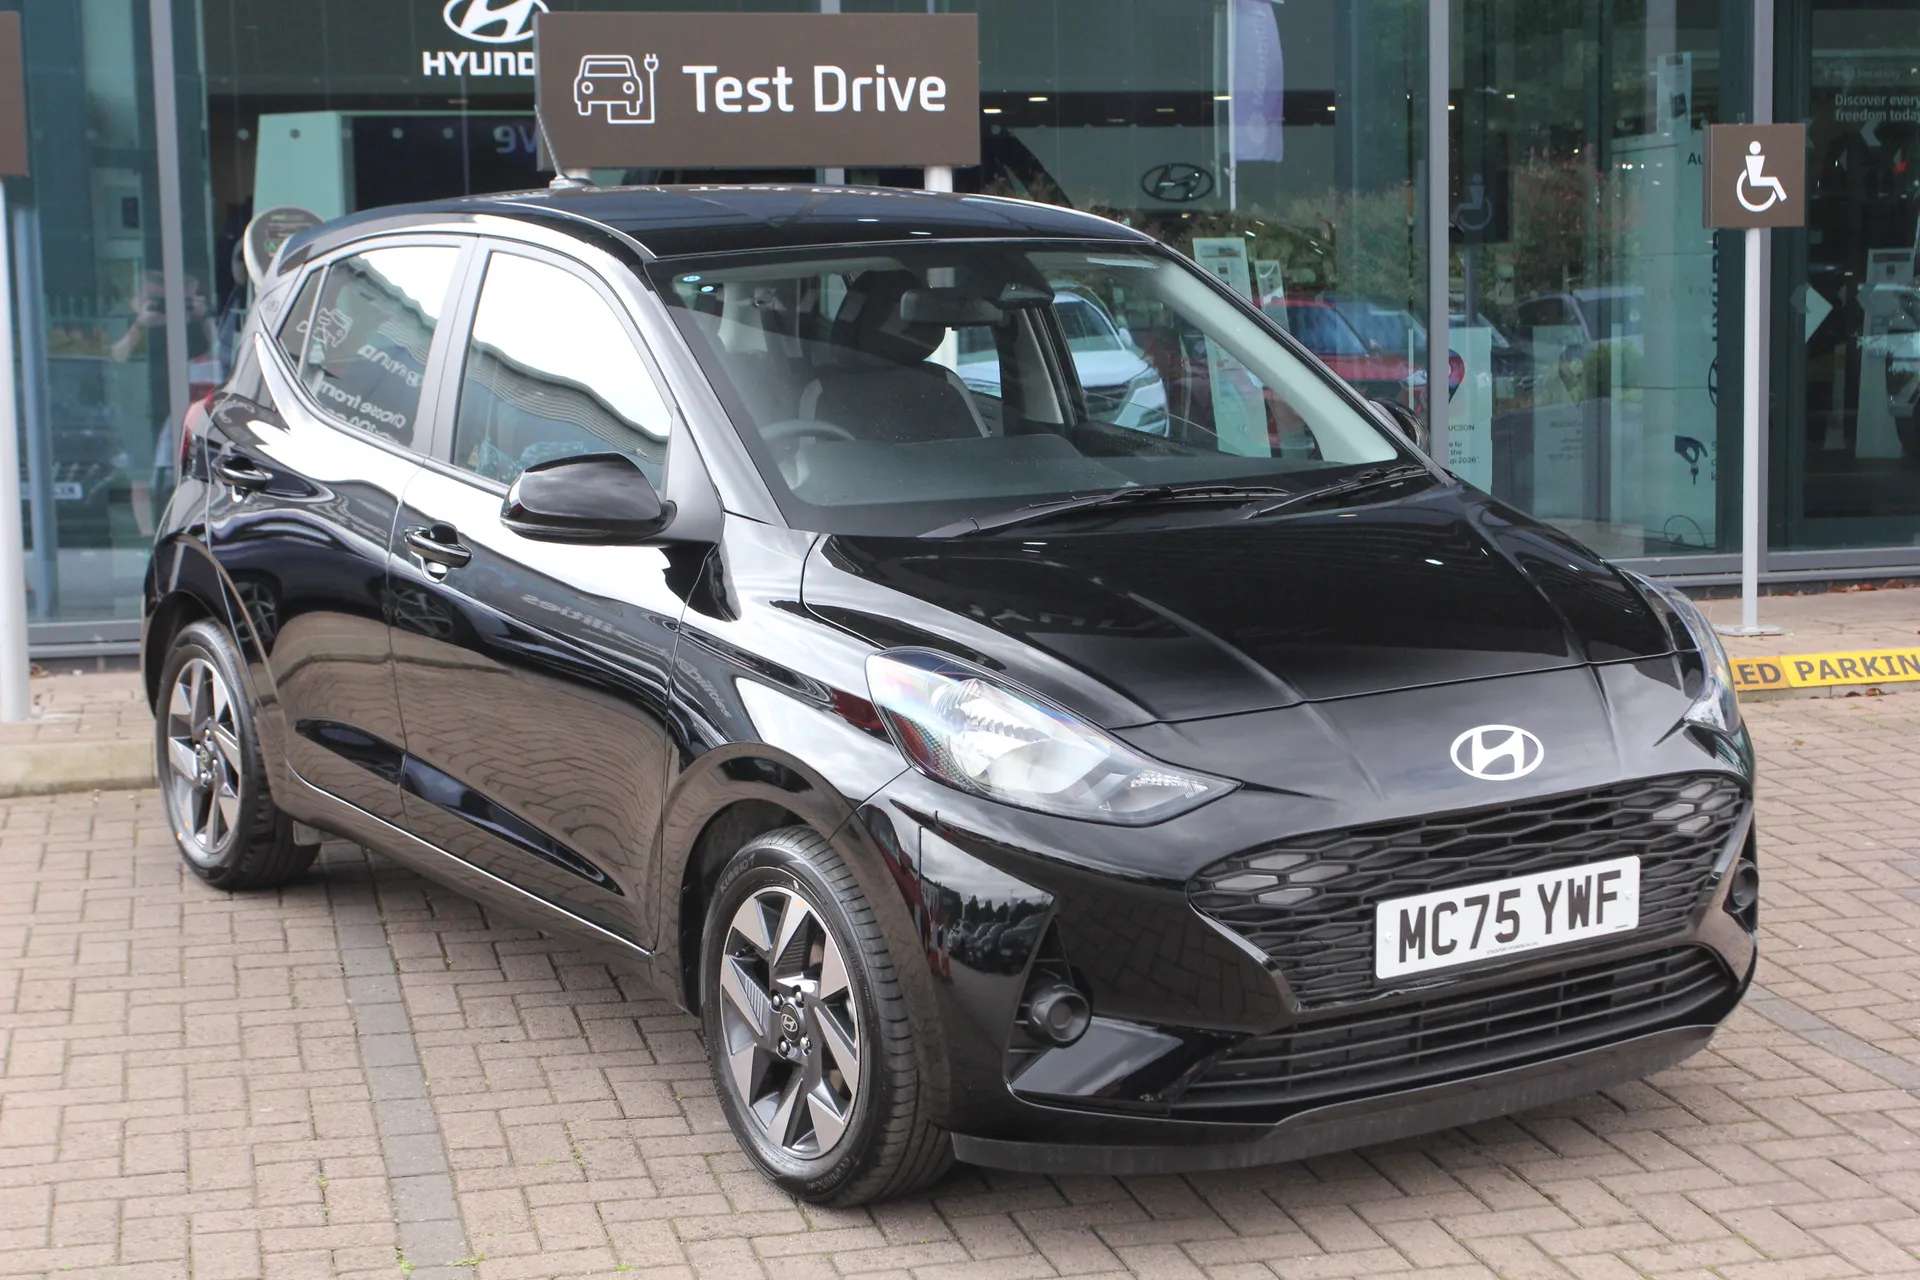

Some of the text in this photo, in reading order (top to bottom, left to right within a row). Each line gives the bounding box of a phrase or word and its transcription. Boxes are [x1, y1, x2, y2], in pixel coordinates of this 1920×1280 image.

[682, 64, 947, 113] Test Drive
[1835, 94, 1887, 106] Discover
[1836, 108, 1887, 121] freedom
[1735, 653, 1920, 686] ED PARKIN
[1399, 869, 1622, 963] MC75 YWF
